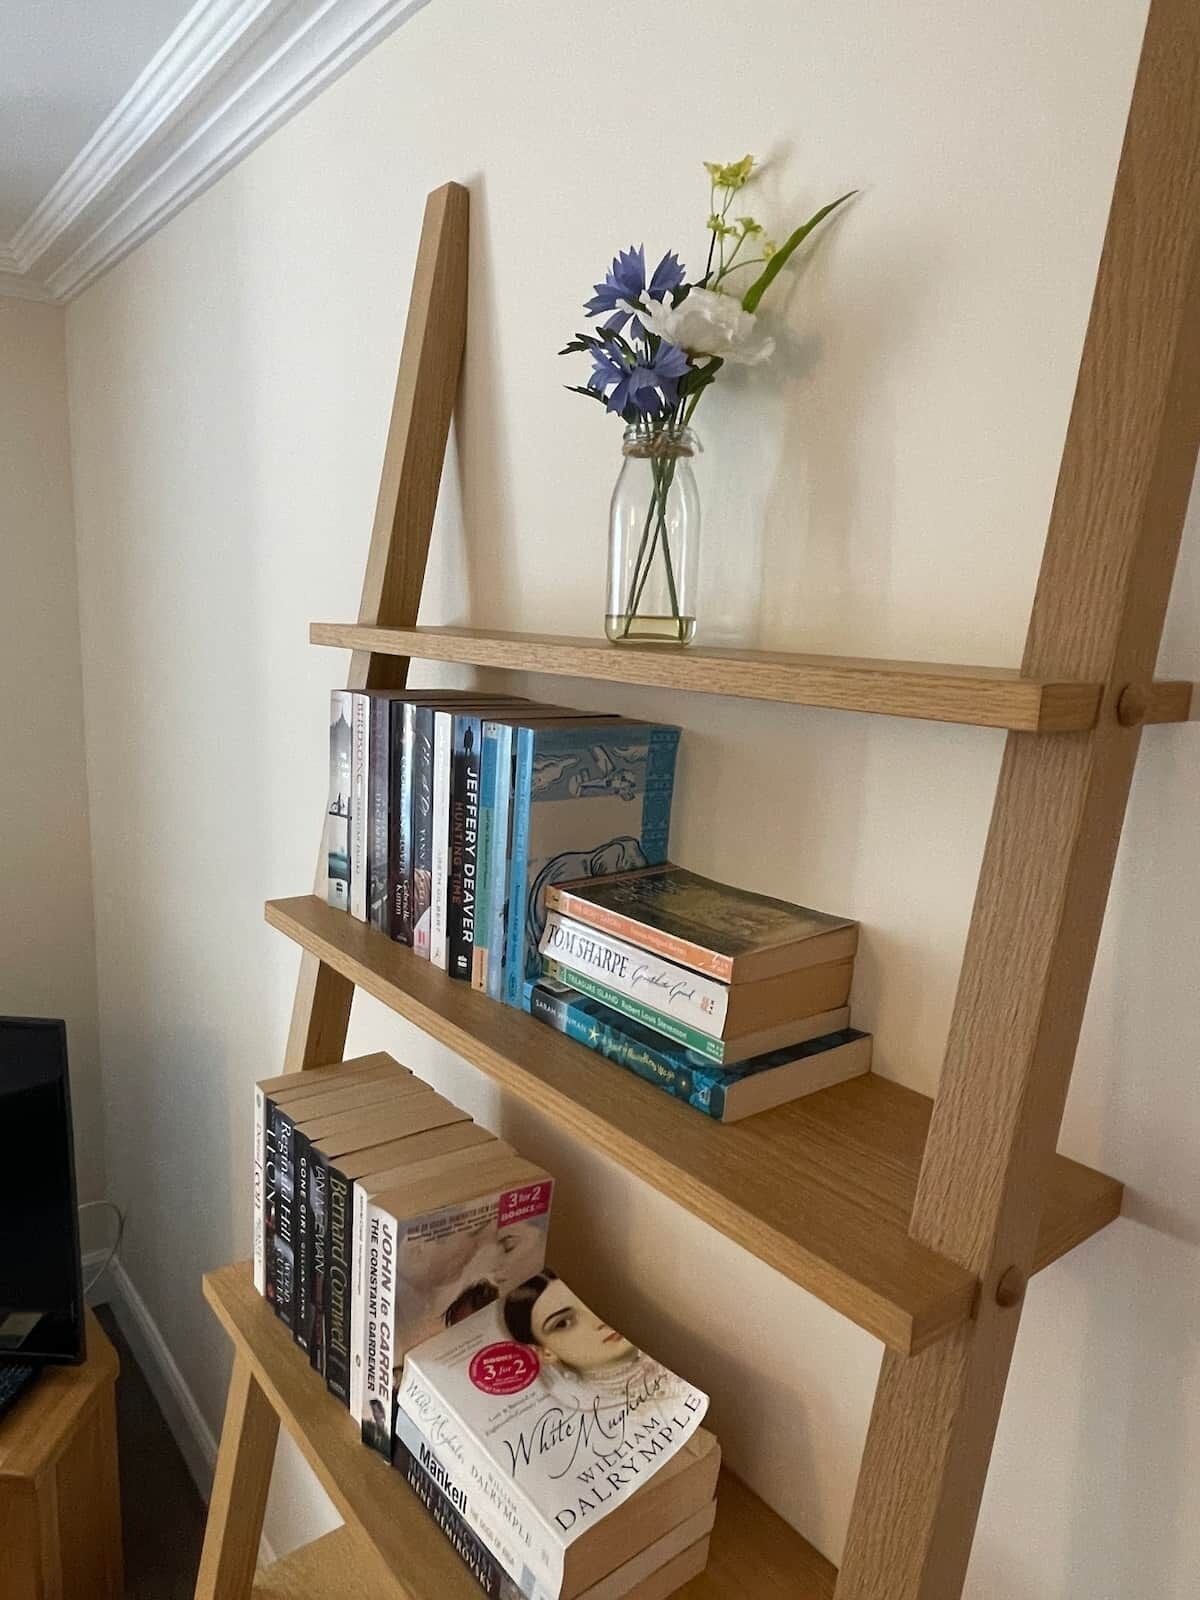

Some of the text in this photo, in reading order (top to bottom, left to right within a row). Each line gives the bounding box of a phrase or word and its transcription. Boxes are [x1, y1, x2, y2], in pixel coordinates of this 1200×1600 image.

[452, 801, 464, 906] HUNTING TIME
[461, 767, 479, 944] JEFFERY DEAVER
[548, 923, 576, 954] TOM
[576, 937, 630, 979] SHARPE
[535, 999, 557, 1016] SARAH
[597, 986, 620, 1006] ISLAND
[620, 999, 689, 1039] Robert Louis Stevenson
[278, 1121, 292, 1243] Reginald Hill
[315, 1165, 326, 1195] IAN
[501, 1204, 535, 1221] BOOKS
[508, 1192, 518, 1208] 3
[532, 1186, 542, 1200] 2
[299, 1204, 307, 1234] GIRL
[329, 1176, 348, 1267] Bernard
[382, 1223, 393, 1292] JOHN
[329, 1265, 348, 1357] Cornwell
[367, 1218, 380, 1392] THE CONSTANT GARDENER
[483, 1359, 527, 1380] 3 for 2
[504, 1400, 577, 1478] White
[548, 1374, 668, 1480] Mughals
[576, 1417, 661, 1484] WILLIAM
[419, 1442, 468, 1515] Mankell
[554, 1393, 703, 1531] DALRYMPLE
[470, 1463, 532, 1547] DALRYMPLE
